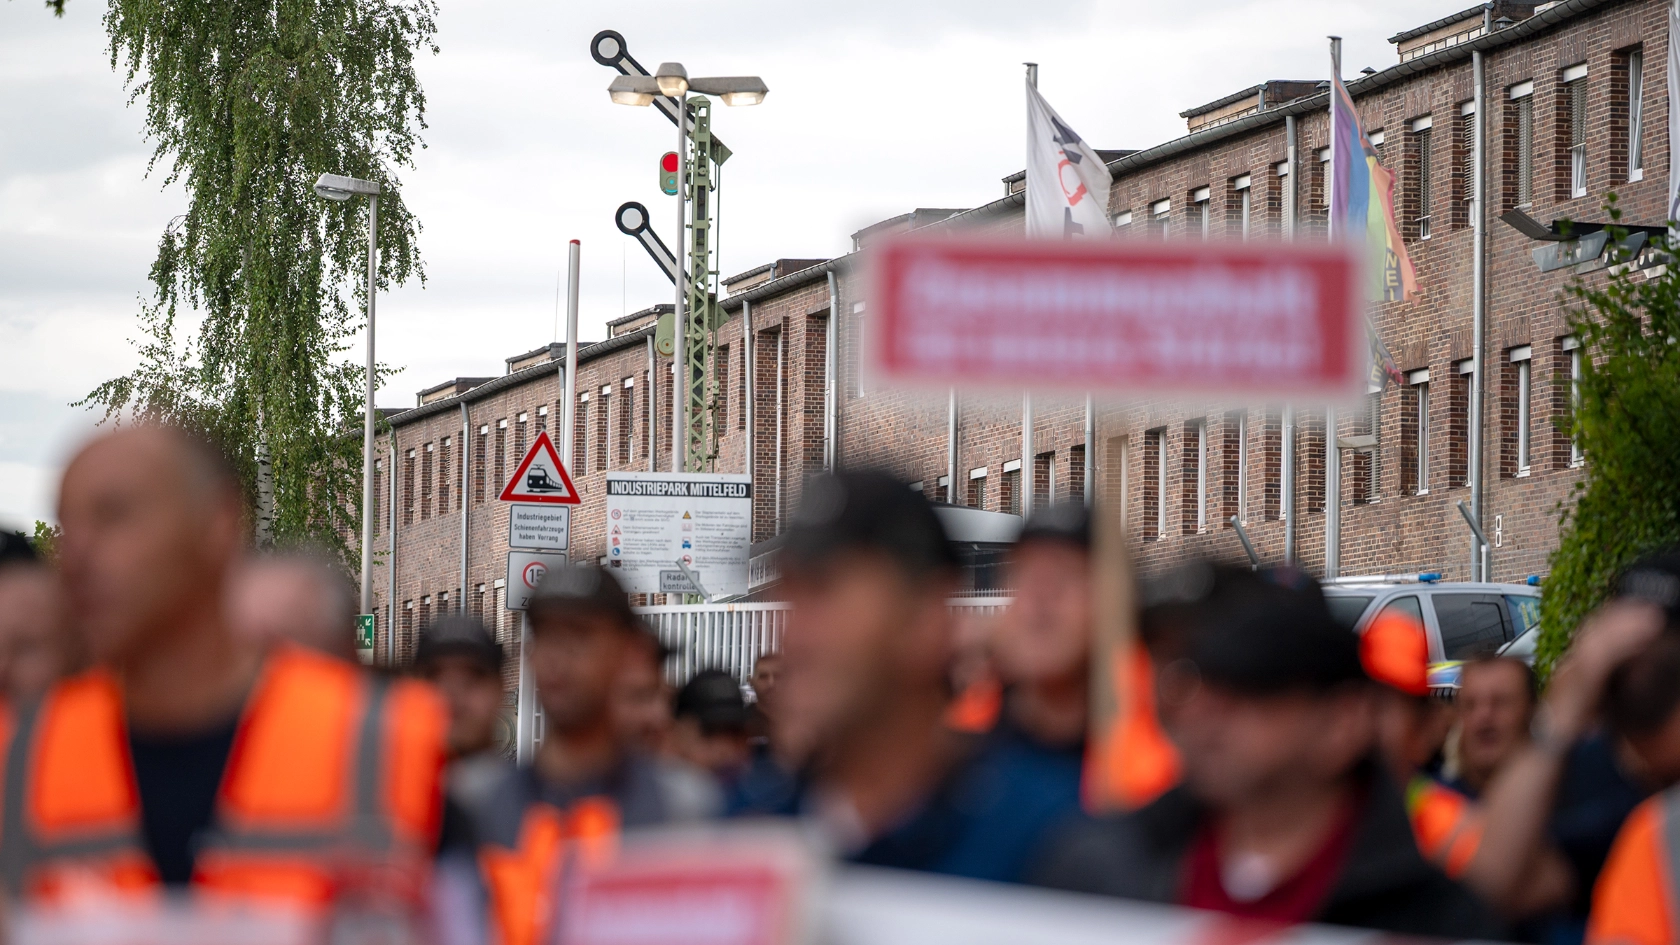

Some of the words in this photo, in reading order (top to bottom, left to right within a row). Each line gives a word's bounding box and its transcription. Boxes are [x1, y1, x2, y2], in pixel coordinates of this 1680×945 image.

[611, 481, 688, 496] INDUSTRIEPARK
[690, 483, 747, 498] MITTELFELD
[517, 512, 562, 522] Industriegebiet
[514, 523, 564, 534] Schienenfahrzeuge
[537, 533, 558, 543] Vorrang
[529, 568, 545, 583] 15
[662, 581, 696, 590] kontrolle
